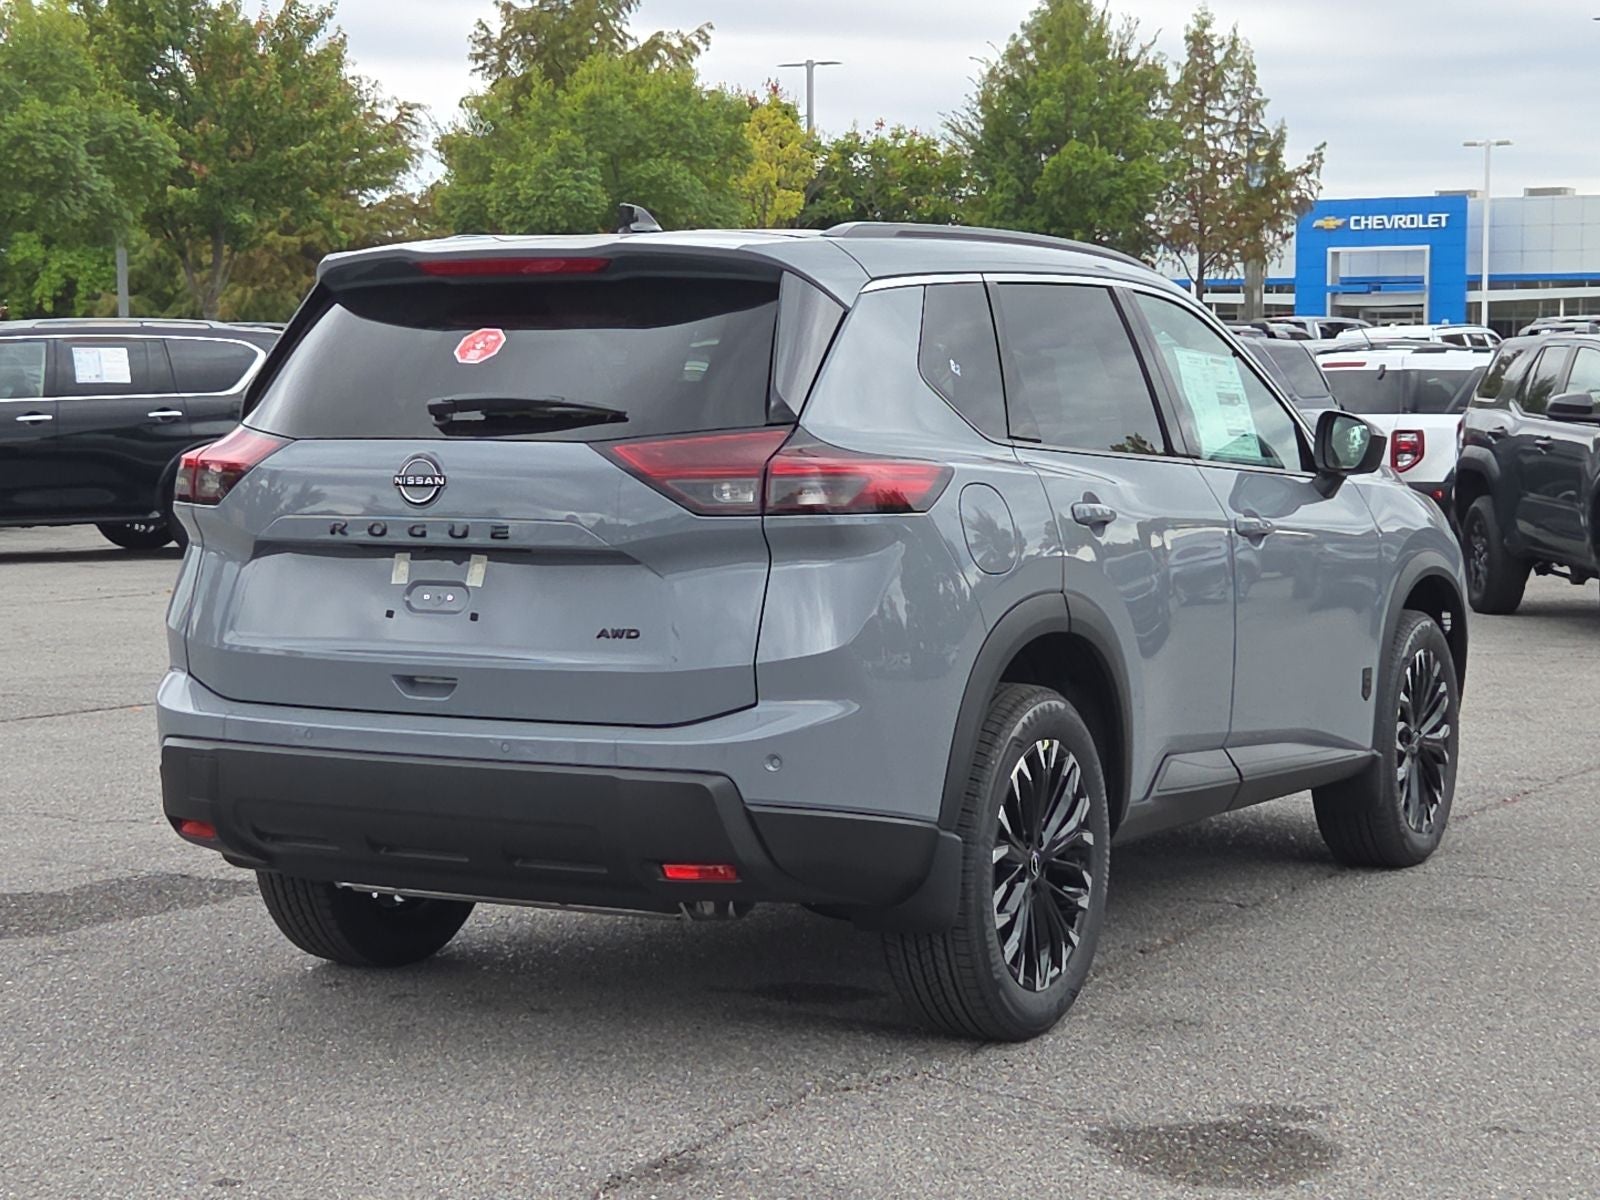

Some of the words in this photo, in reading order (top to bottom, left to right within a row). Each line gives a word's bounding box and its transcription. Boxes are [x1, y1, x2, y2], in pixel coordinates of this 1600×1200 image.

[1350, 213, 1450, 230] CHEVROLET
[393, 475, 446, 486] NISSAN
[329, 520, 510, 540] ROGUE
[596, 628, 641, 640] AWD
